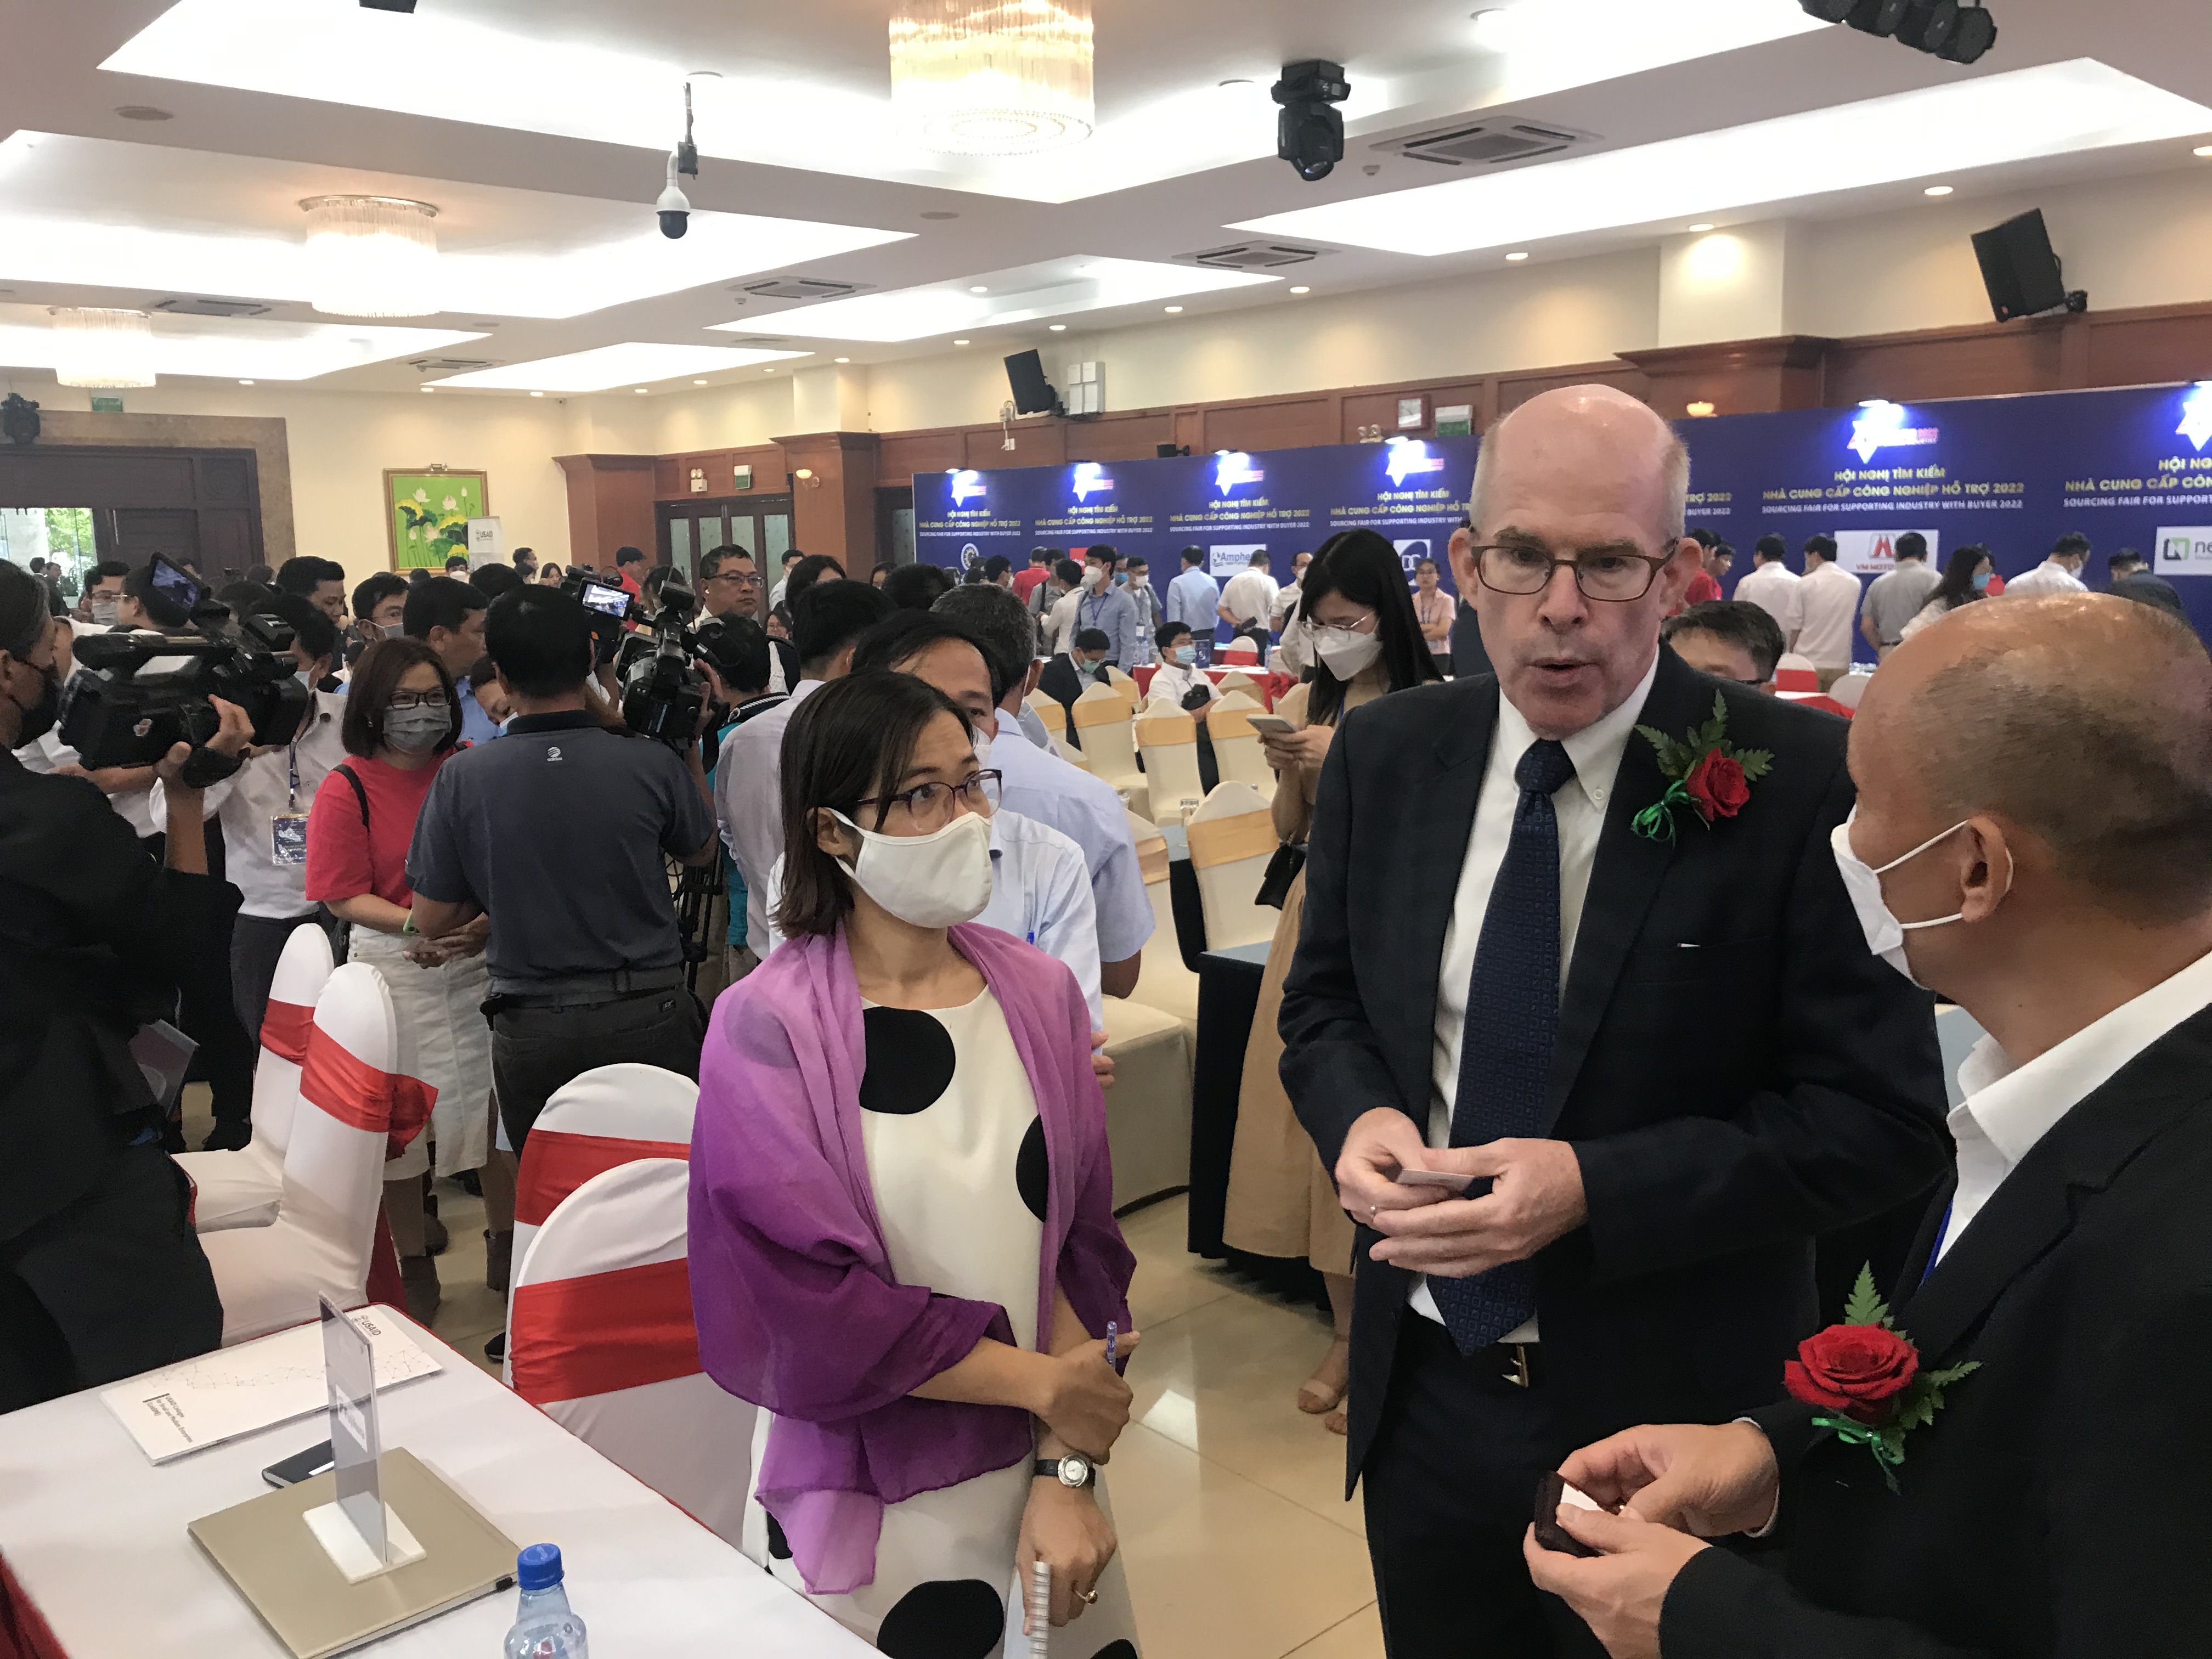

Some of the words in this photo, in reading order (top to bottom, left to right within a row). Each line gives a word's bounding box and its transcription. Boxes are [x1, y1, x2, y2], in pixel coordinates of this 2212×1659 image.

[2158, 456, 2186, 473] HỘI
[1834, 469, 1857, 483] HỘI
[1859, 469, 1890, 482] NGHỊ
[1892, 466, 1913, 479] TÌM
[1916, 464, 1945, 478] KIẾM
[1762, 488, 1786, 500] NHÀ
[1788, 488, 1822, 499] CUNG
[1826, 483, 1850, 498] CẤP
[1853, 484, 1890, 497] CÔNG
[1893, 482, 1939, 498] NGHIỆP
[1942, 480, 1961, 495] HỖ
[1964, 482, 1990, 496] TRỢ
[1993, 482, 2024, 494] 2022
[2065, 477, 2095, 492] NHÀ
[2100, 478, 2143, 491] CUNG
[2146, 474, 2179, 489] CẤP
[1762, 505, 1802, 514] SOURCING
[1803, 504, 1821, 512] FAIR
[1823, 503, 1839, 512] FOR
[1841, 502, 1894, 512] SUPPORTING
[1896, 501, 1940, 510] INDUSTRY
[1942, 500, 1966, 509] WITH
[1967, 500, 1998, 509] BUYER
[2000, 499, 2023, 509] 2022
[2063, 497, 2115, 507] SOURCING
[2118, 496, 2141, 506] FAIR
[2142, 495, 2164, 505] FOR
[1221, 552, 1250, 564] Amphe
[362, 1321, 381, 1335] USAID
[166, 1396, 177, 1406] USAID
